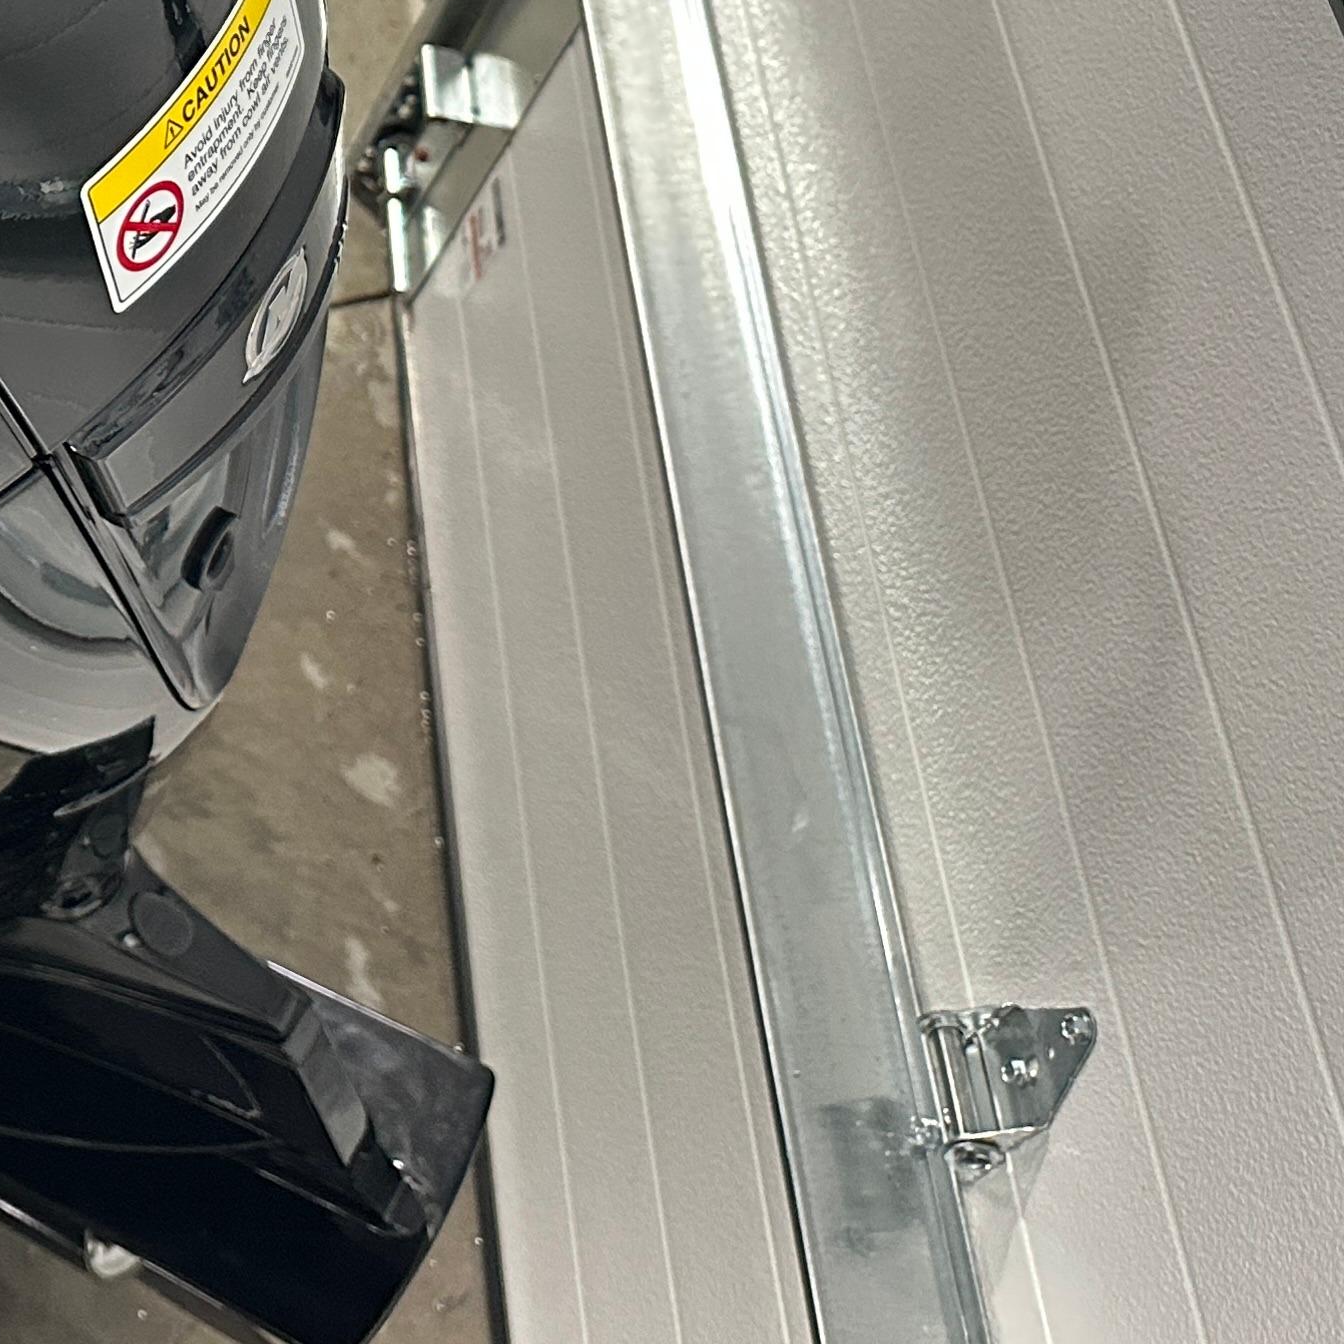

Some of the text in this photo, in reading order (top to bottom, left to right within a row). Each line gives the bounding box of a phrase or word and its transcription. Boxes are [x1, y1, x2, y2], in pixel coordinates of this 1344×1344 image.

[182, 15, 251, 123] CAUTION
[184, 17, 276, 170] Avoid injury from finger
[187, 102, 245, 182] entrapment.
[246, 61, 267, 99] Keep
[192, 157, 219, 196] away
[219, 126, 242, 160] from
[242, 92, 261, 128] cowl
[261, 73, 271, 96] air
[195, 192, 210, 212] May
